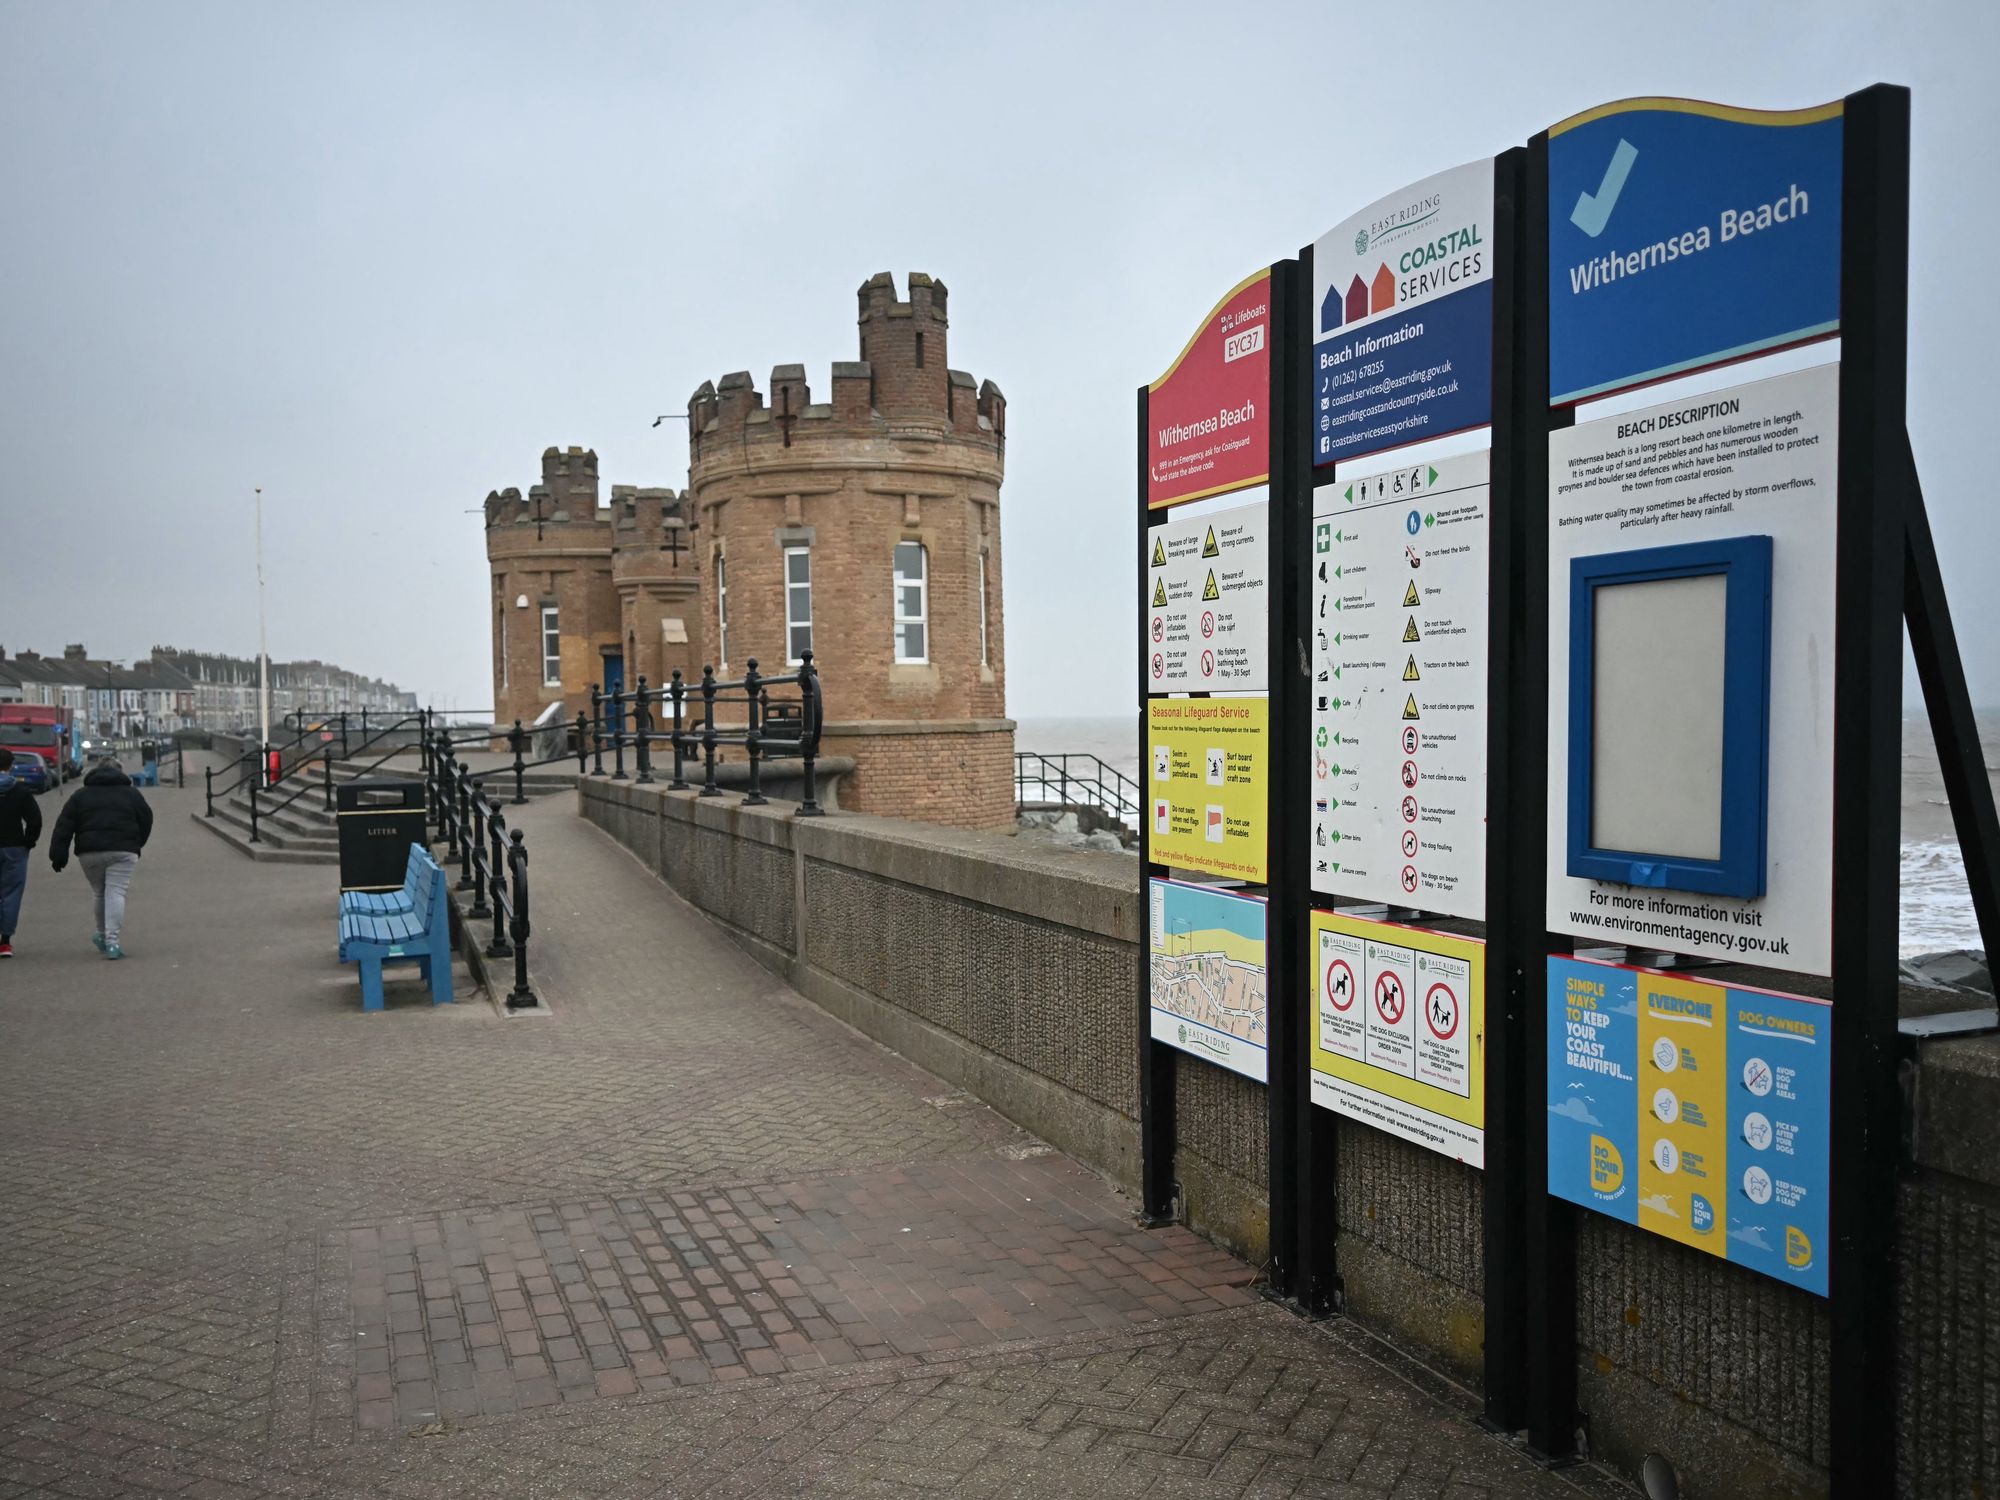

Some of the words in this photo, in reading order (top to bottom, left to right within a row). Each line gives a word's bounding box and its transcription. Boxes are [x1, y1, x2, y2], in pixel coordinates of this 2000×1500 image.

[1371, 214, 1396, 234] EAST
[1400, 194, 1440, 221] RIDING
[1400, 224, 1482, 273] COASTAL
[1570, 226, 1710, 294] Withernsea
[1720, 184, 1808, 242] Beach
[1400, 252, 1481, 302] SERVICES
[1235, 304, 1266, 325] Lifeboats
[1229, 331, 1258, 357] EYC37
[1321, 345, 1352, 369] Beach
[1355, 322, 1423, 357] Information
[1332, 370, 1357, 389] (01262)
[1359, 360, 1384, 379] 678255
[1332, 360, 1451, 406] coastal.services@eastriding.gov.uk
[1332, 380, 1458, 426] eastridingcoastandcountryside.co.uk
[1159, 416, 1217, 448] Withernsea
[1220, 399, 1254, 429] Beach
[1332, 414, 1428, 448] coastalserviceseastyorkshire
[1618, 418, 1655, 438] BEACH
[1659, 399, 1739, 429] DESCRIPTION
[1168, 459, 1172, 467] in
[1179, 453, 1203, 464] Emergency,
[1222, 435, 1250, 452] Coastguard
[1568, 454, 1604, 467] Withernsea
[1606, 448, 1626, 460] beach
[1628, 447, 1633, 455] is
[1641, 442, 1656, 452] long
[1659, 437, 1680, 448] resort
[1682, 432, 1704, 444] beach
[1707, 429, 1721, 439] one
[1723, 420, 1761, 436] kilometre
[1764, 417, 1771, 426] in
[1774, 410, 1804, 425] length.
[1586, 467, 1603, 476] made
[1606, 464, 1614, 472] up
[1616, 461, 1623, 469] of
[1625, 459, 1641, 468] sand
[1643, 455, 1656, 464] and
[1658, 449, 1686, 463] pebbles
[1688, 444, 1703, 455] and
[1705, 441, 1718, 451] has
[1721, 435, 1761, 448] numerous
[1764, 426, 1798, 440] wooden
[1169, 470, 1178, 480] state
[1188, 464, 1202, 475] above
[1203, 460, 1214, 470] code
[1558, 482, 1582, 494] groynes
[1585, 478, 1597, 488] and
[1598, 473, 1624, 485] boulder
[1626, 472, 1636, 480] sea
[1639, 464, 1669, 477] defences
[1672, 458, 1694, 470] which
[1696, 455, 1714, 466] have
[1717, 451, 1735, 462] been
[1738, 443, 1773, 458] installed
[1776, 442, 1784, 451] to
[1787, 435, 1819, 451] protect
[1622, 483, 1633, 492] the
[1635, 479, 1653, 489] town
[1655, 475, 1672, 486] from
[1675, 470, 1700, 482] coastal
[1703, 465, 1734, 477] erosion.
[1559, 516, 1582, 526] Bathing
[1585, 513, 1603, 522] water
[1605, 508, 1628, 520] quality
[1630, 505, 1644, 515] may
[1646, 498, 1685, 512] sometimes
[1687, 497, 1696, 506] be
[1698, 489, 1730, 504] affected
[1733, 489, 1742, 499] by
[1745, 485, 1769, 496] storm
[1772, 478, 1816, 491] overflows,
[1620, 515, 1659, 530] particularly
[1661, 511, 1678, 522] after
[1681, 509, 1702, 519] heavy
[1705, 502, 1734, 515] rainfall.
[1168, 539, 1182, 547] Beware
[1188, 536, 1198, 545] large
[1221, 528, 1236, 537] Beware
[1238, 525, 1243, 533] of
[1221, 540, 1235, 548] strong
[1236, 536, 1254, 545] currents
[1168, 549, 1185, 558] breaking
[1441, 547, 1450, 555] feed
[1222, 572, 1237, 580] Beware
[1238, 570, 1243, 578] of
[1222, 580, 1246, 591] submerged
[1247, 579, 1263, 588] objects
[1153, 706, 1181, 717] Seasonal
[1185, 706, 1217, 720] Lifeguard
[1221, 706, 1249, 718] Service
[1590, 890, 1608, 905] For
[1612, 896, 1644, 910] more
[1649, 896, 1727, 921] information
[1733, 908, 1762, 926] visit
[1570, 912, 1789, 954] www.environmentagency.gov.uk
[1567, 977, 1605, 996] SIMPLE
[1567, 993, 1597, 1009] WAYS
[1649, 993, 1712, 1019] EVERYONE
[1567, 1008, 1581, 1021] TO
[1583, 1011, 1610, 1028] KEEP
[1739, 1010, 1764, 1025] DOG
[1767, 1016, 1815, 1036] OWNERS
[1188, 1029, 1204, 1040] EAST
[1206, 1034, 1230, 1051] RIDING
[1567, 1023, 1596, 1041] YOUR
[1567, 1037, 1605, 1058] COAST
[1567, 1052, 1632, 1081] BEAUTIFUL...
[1348, 1101, 1361, 1112] further
[1363, 1107, 1385, 1121] information
[1387, 1118, 1396, 1126] visit
[1595, 1146, 1608, 1158] DO
[1595, 1158, 1618, 1175] YOUR
[1595, 1171, 1608, 1184] BIT
[1776, 1180, 1789, 1190] KEEP
[1791, 1184, 1806, 1195] YOUR
[1776, 1189, 1789, 1197] DOG
[1791, 1193, 1800, 1201] ON
[1694, 1200, 1704, 1209] DO
[1694, 1209, 1711, 1220] YOUR
[1694, 1216, 1703, 1225] BIT
